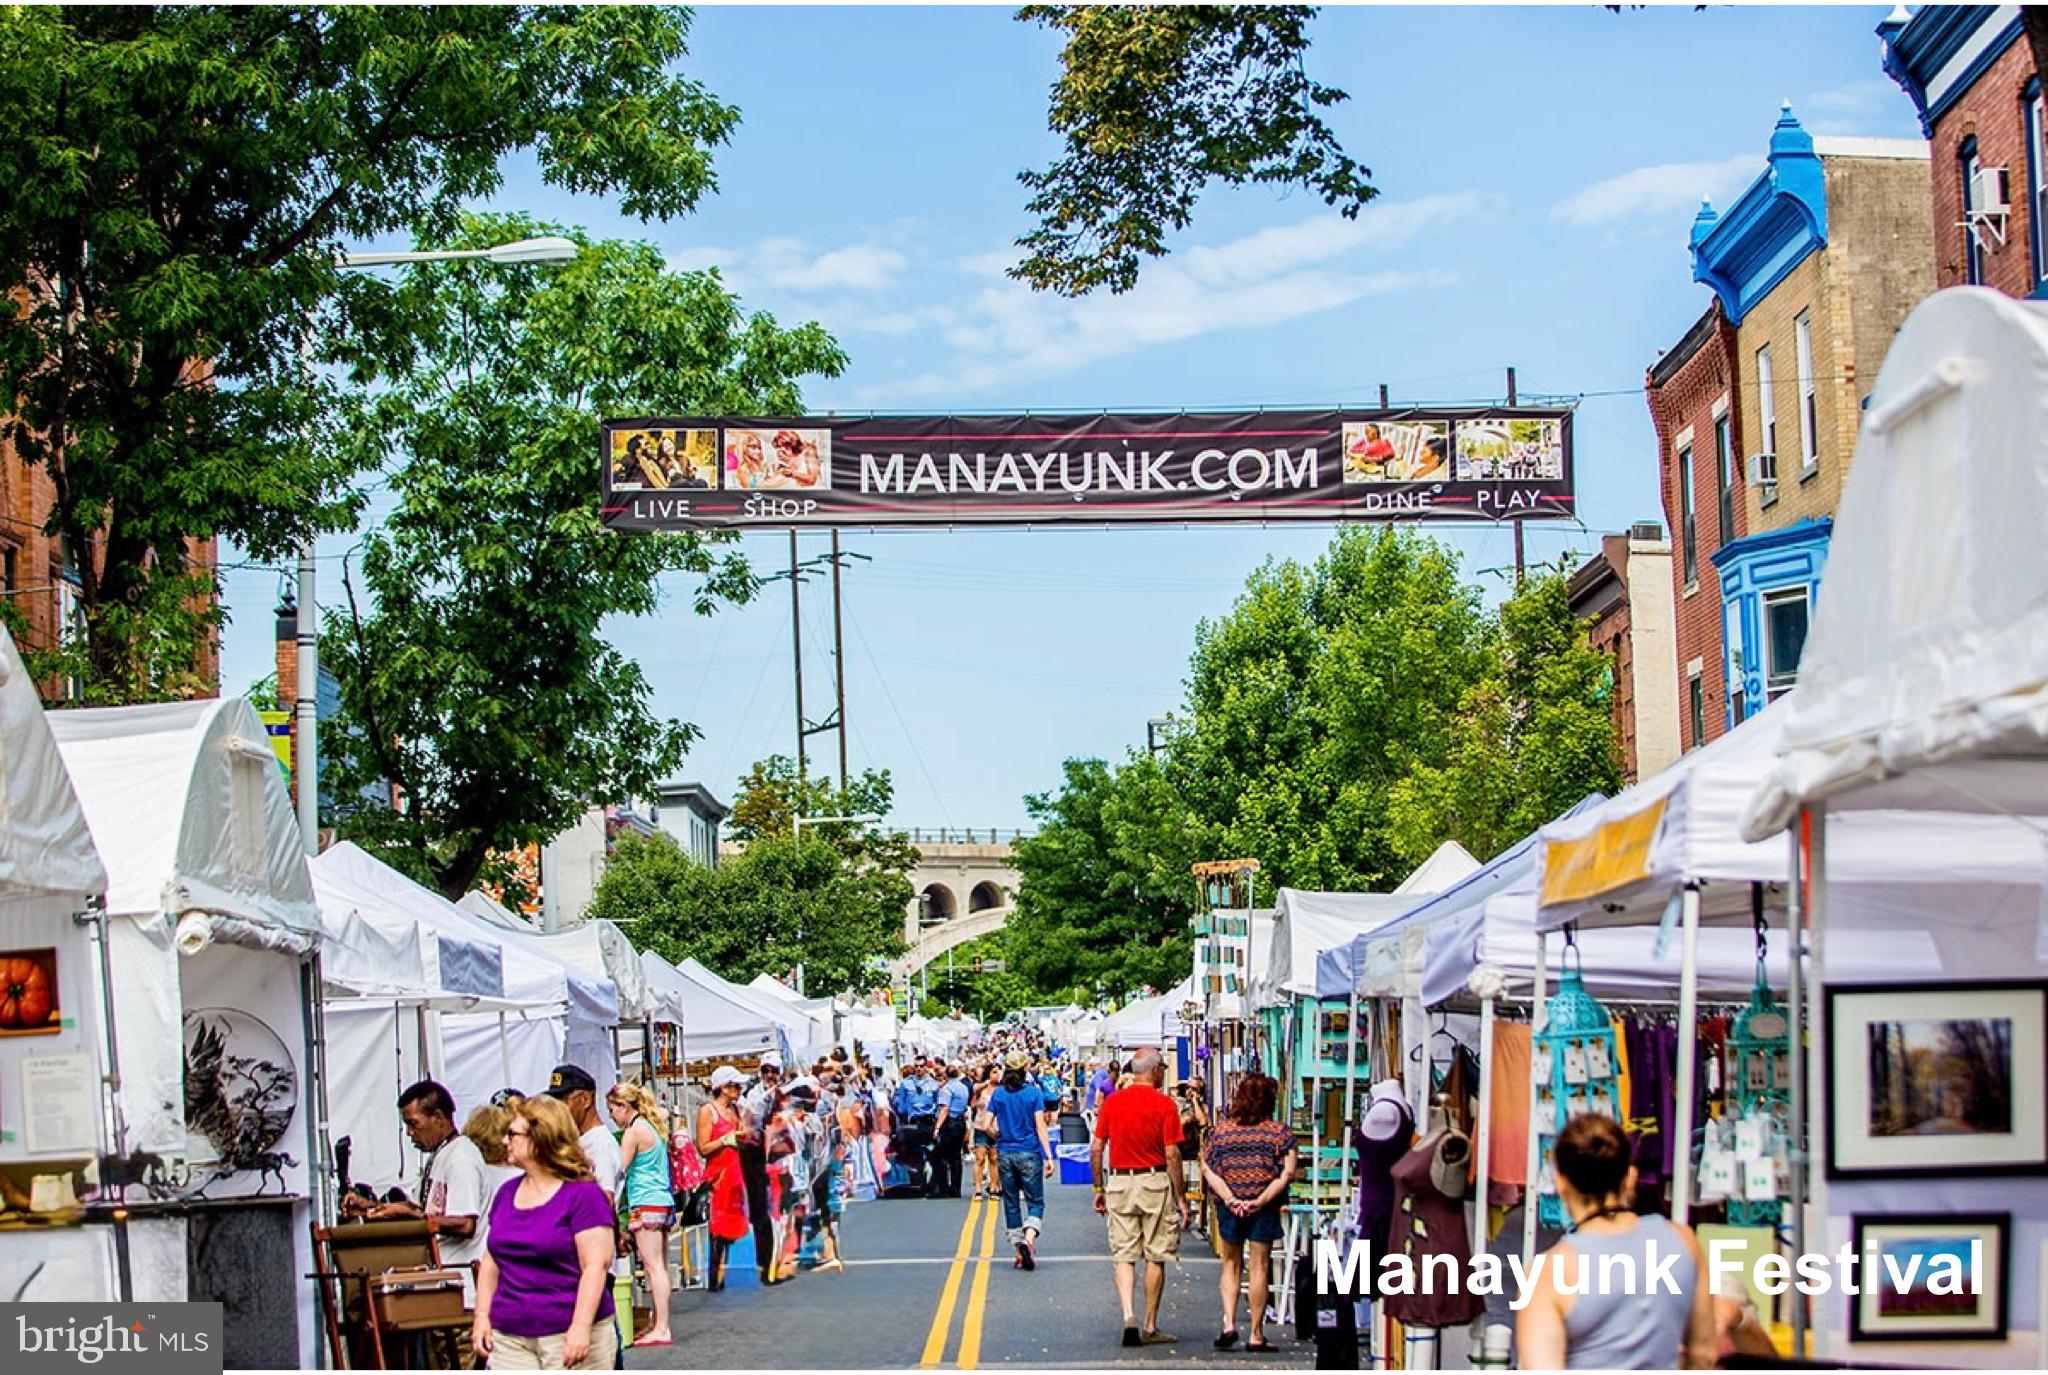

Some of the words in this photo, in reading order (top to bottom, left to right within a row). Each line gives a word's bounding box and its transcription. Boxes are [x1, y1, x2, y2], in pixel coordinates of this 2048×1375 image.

[860, 448, 1318, 494] MANAYUNK.COM
[1366, 491, 1433, 510] DINE
[1477, 488, 1541, 509] PLAY
[634, 499, 690, 518] LIVE
[743, 499, 817, 518] SHOP
